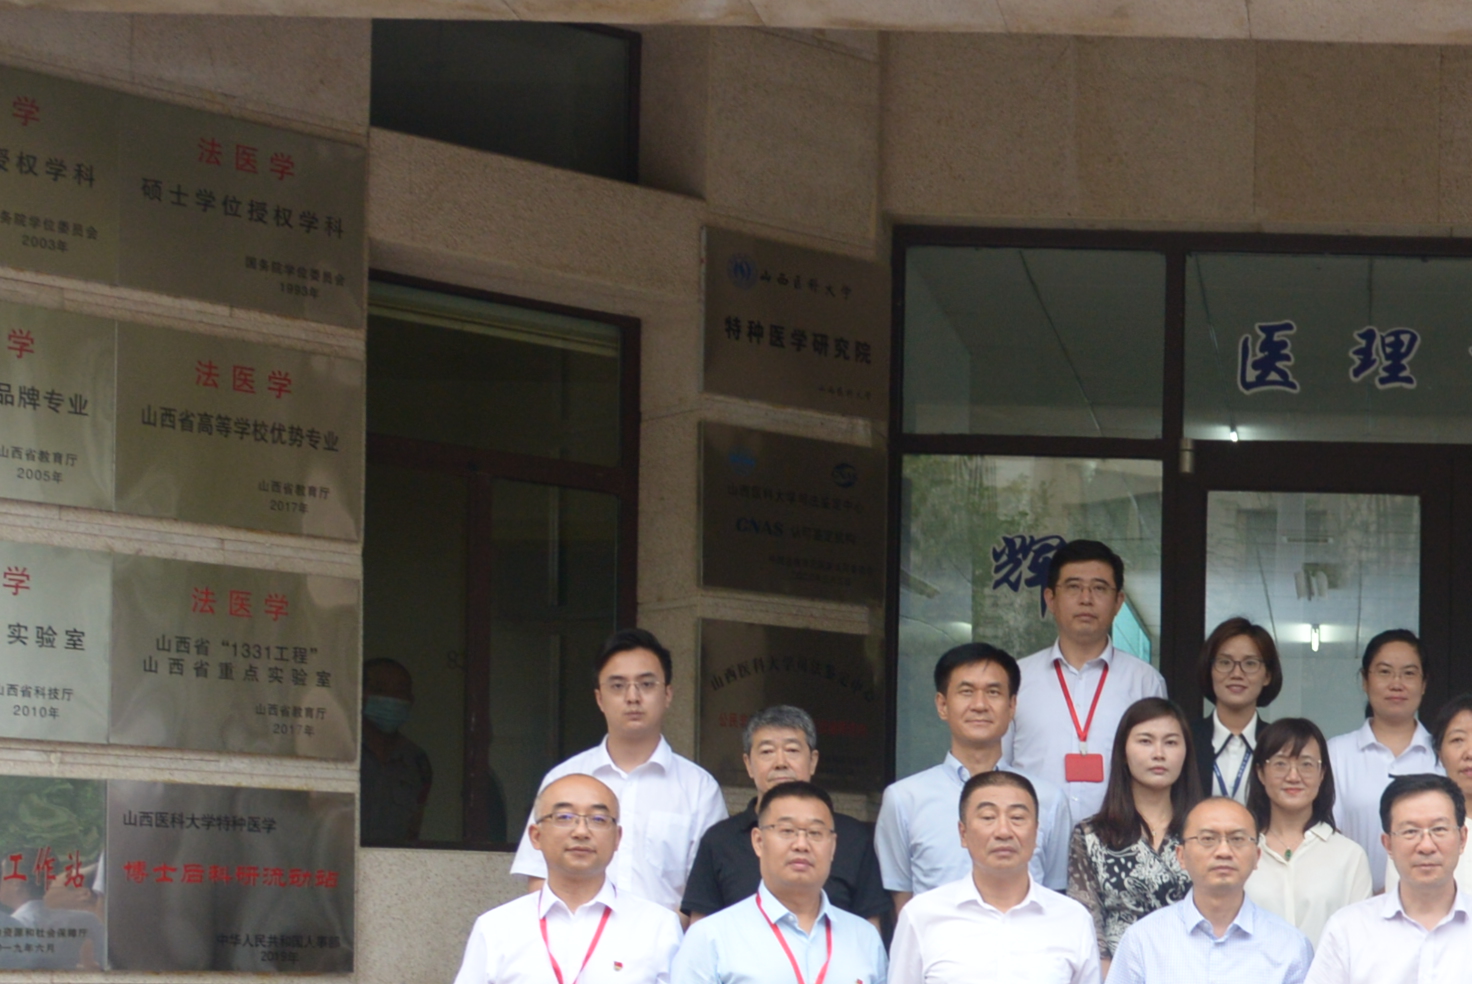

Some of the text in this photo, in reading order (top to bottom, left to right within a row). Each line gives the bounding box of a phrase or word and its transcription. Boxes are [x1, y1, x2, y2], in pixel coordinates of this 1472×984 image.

[12, 96, 40, 127] 学
[198, 138, 295, 181] 法医学
[141, 177, 344, 239] 硕士学位授权学科
[22, 234, 68, 253] 2003年
[245, 255, 346, 287] 国务院学位委员会
[7, 328, 35, 359] 学
[723, 315, 873, 364] 特种医学研究院
[195, 360, 292, 399] 法医学
[0, 382, 89, 417] 品牌专业
[141, 404, 340, 453] 山西省高等学校优势专业
[16, 467, 63, 484] 2005年
[258, 480, 331, 501] 山西省教育厅
[270, 499, 309, 515] 2017年
[735, 516, 784, 537] CNAS
[3, 566, 30, 596] 学
[191, 586, 290, 622] 法医学
[7, 622, 86, 651] 实验室
[143, 655, 332, 689] 山西省重点实验室
[0, 683, 74, 702] 西省科技厅
[13, 704, 60, 720] 2010年
[255, 702, 327, 721] 山西省教育厅
[123, 810, 277, 834] 山西医科大学特种医学
[3, 845, 86, 892] 工作站
[123, 860, 340, 889] 博士后科研流动站
[0, 927, 88, 938] 资源和社会保障厅
